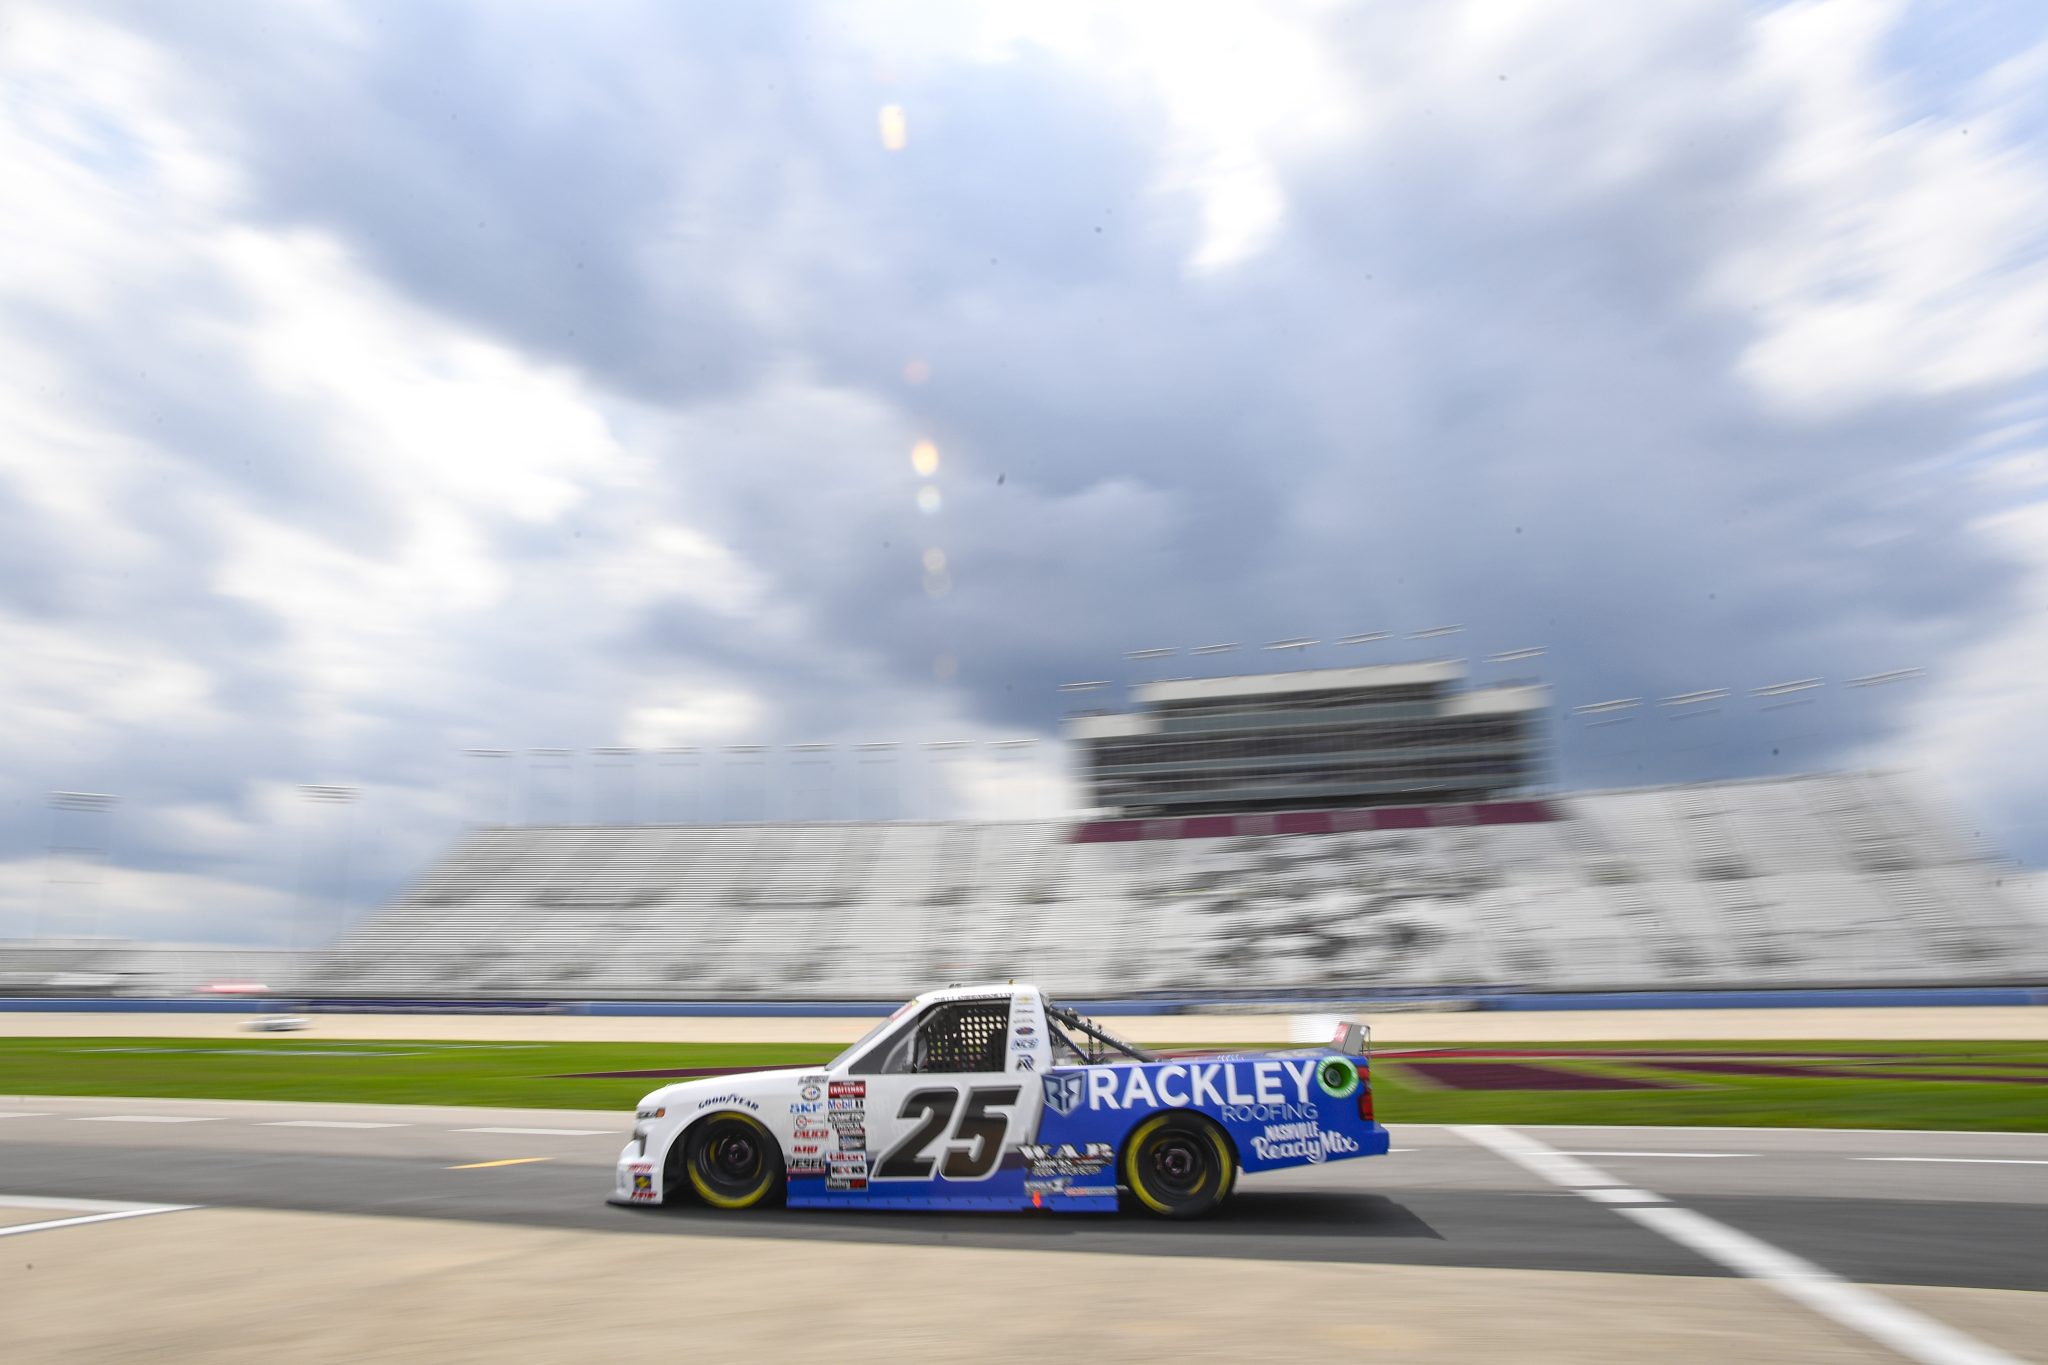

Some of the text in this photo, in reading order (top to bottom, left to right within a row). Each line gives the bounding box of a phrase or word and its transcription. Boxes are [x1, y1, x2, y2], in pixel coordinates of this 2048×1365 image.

[1087, 1060, 1317, 1111] RACKLEY
[698, 1093, 759, 1111] GOODYEAR
[828, 1099, 853, 1110] Mobil
[1221, 1102, 1319, 1122] ROOFING
[869, 1085, 1022, 1181] 25
[1264, 1121, 1320, 1143] NASHVILLE
